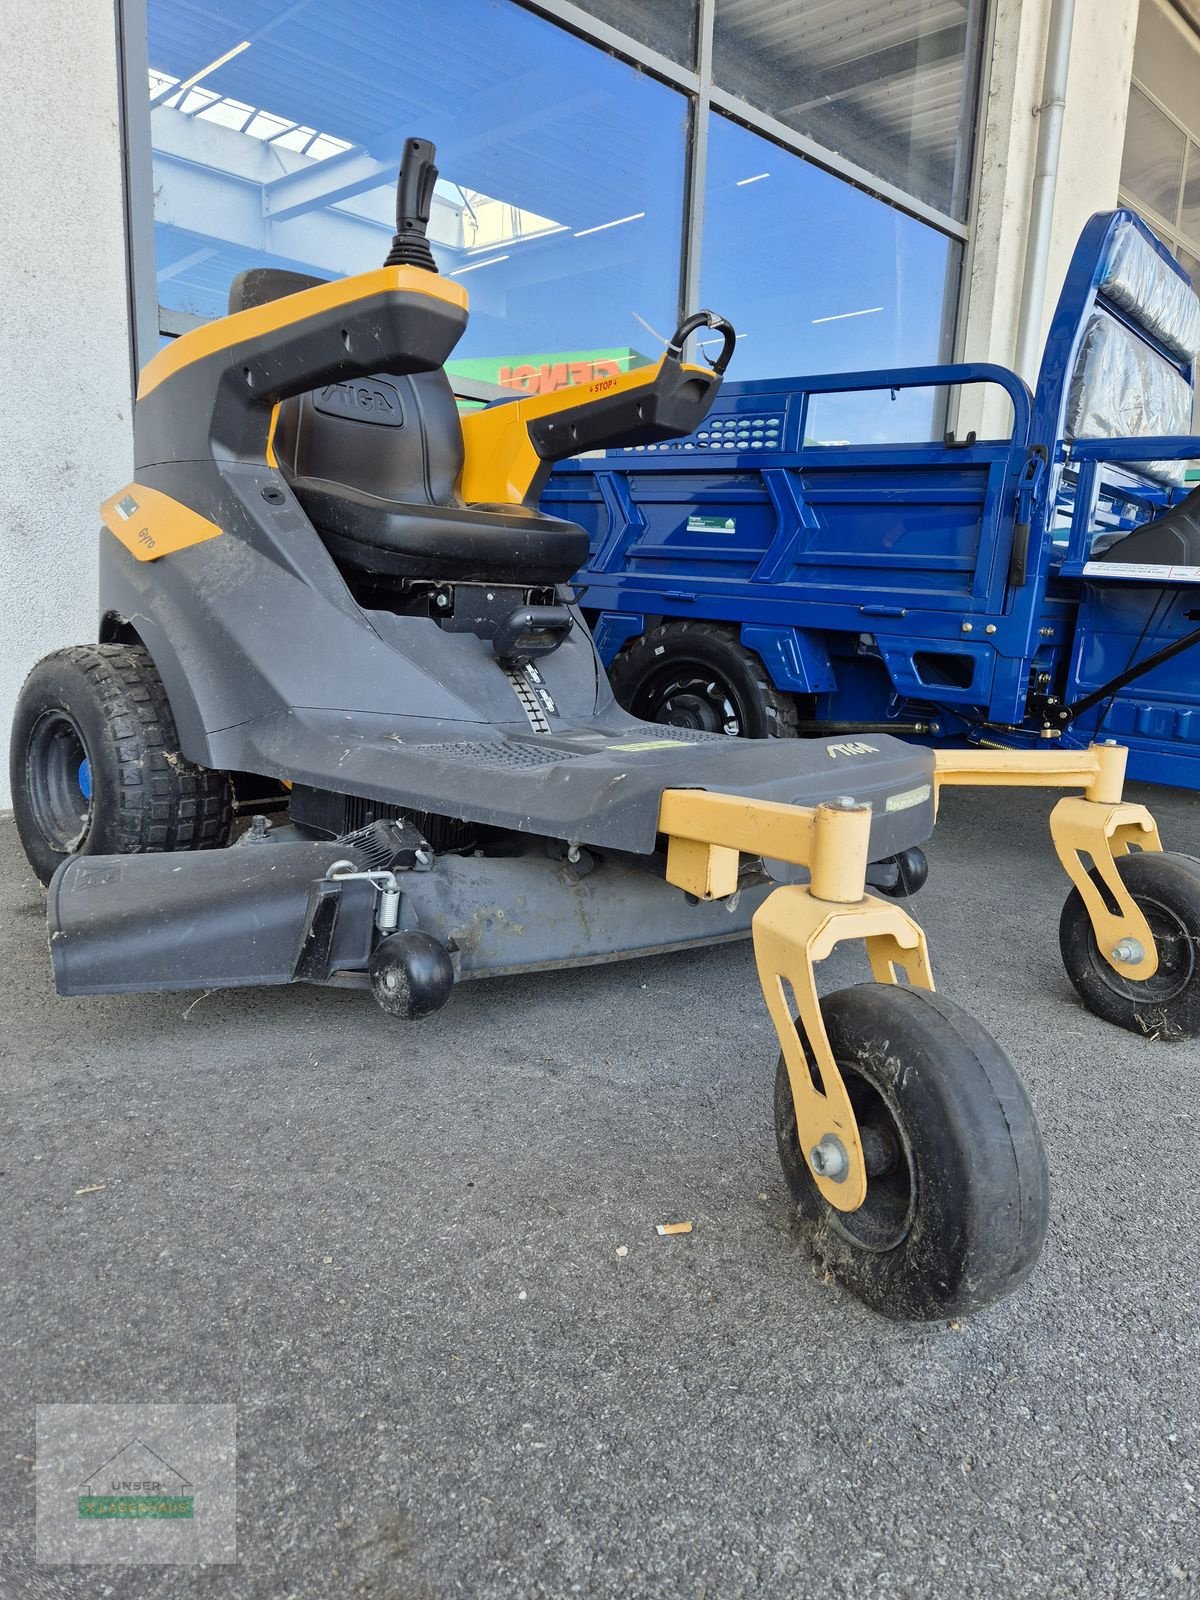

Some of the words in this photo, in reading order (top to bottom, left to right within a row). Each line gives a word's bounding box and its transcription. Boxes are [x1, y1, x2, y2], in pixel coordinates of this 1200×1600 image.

[594, 379, 613, 393] STOP
[321, 383, 395, 416] STIGA
[138, 527, 156, 549] Gyro
[826, 741, 880, 759] STIGA
